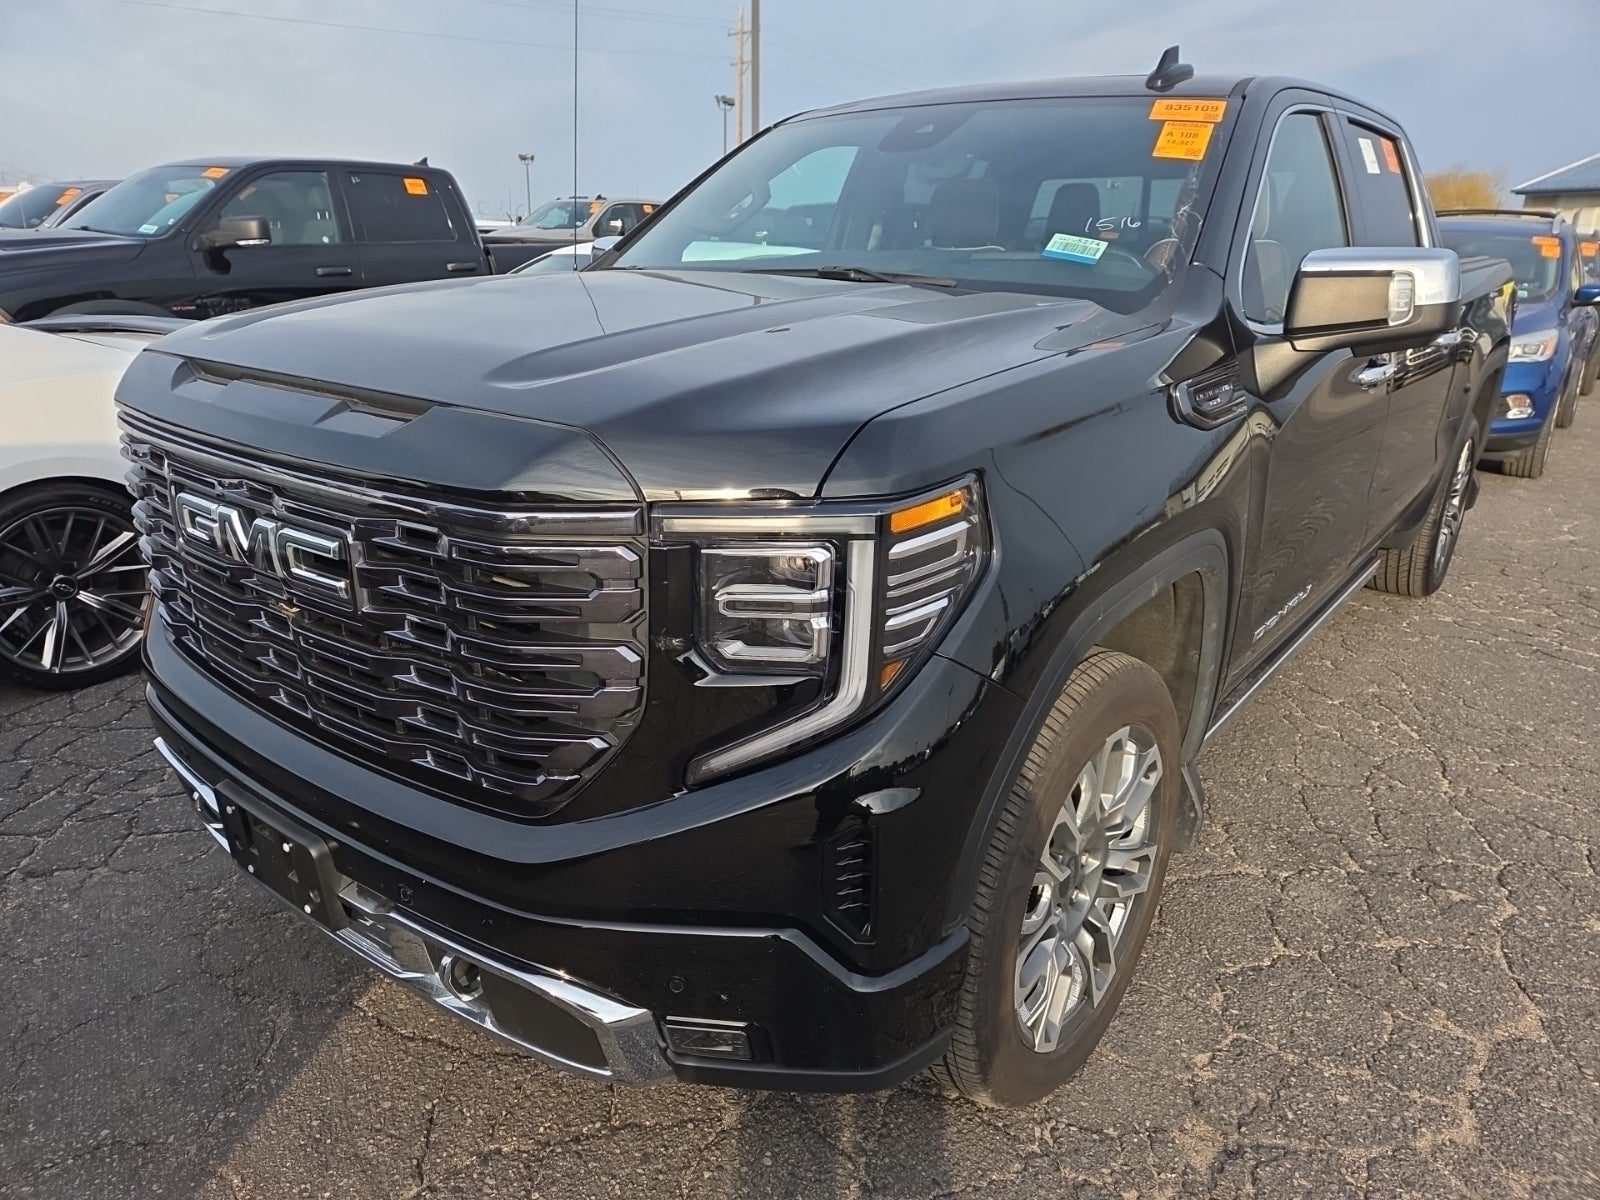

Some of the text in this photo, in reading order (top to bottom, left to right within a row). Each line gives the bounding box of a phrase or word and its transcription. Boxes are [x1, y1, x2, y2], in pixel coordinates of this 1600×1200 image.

[1164, 103, 1220, 113] 835109
[1179, 131, 1200, 139] 108
[1084, 216, 1142, 233] 1516
[175, 492, 351, 600] GMC
